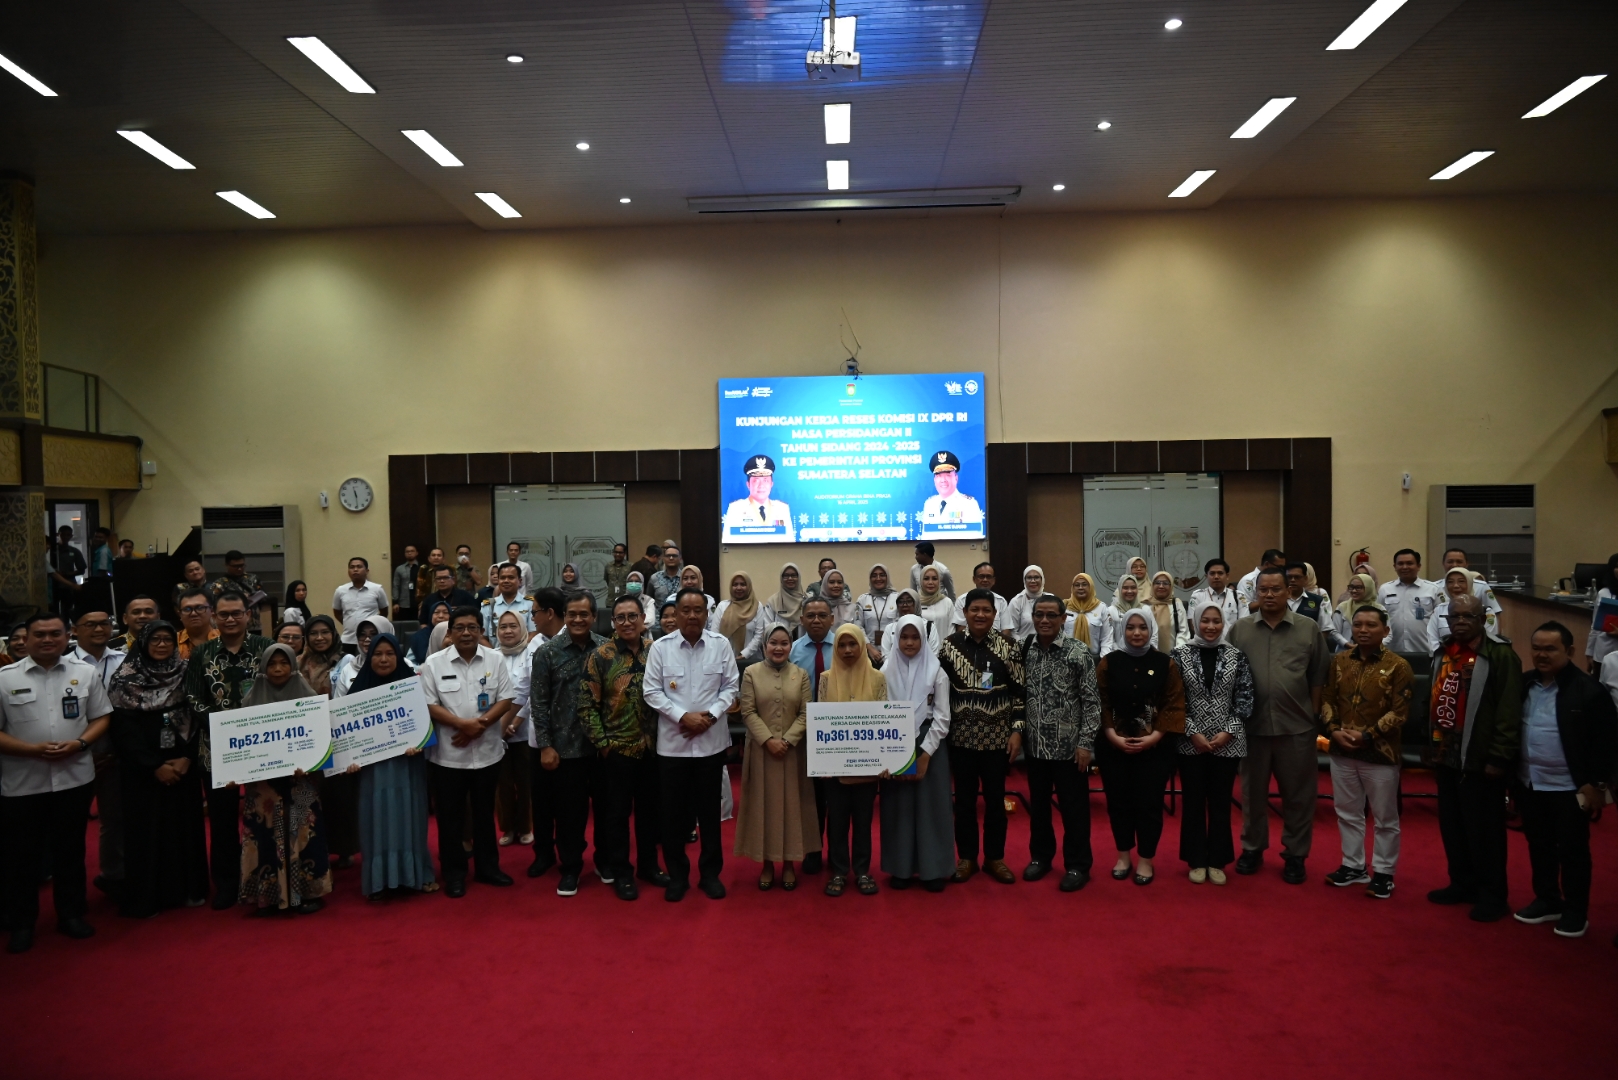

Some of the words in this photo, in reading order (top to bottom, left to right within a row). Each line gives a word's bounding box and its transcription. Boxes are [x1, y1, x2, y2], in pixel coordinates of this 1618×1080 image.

[736, 417, 802, 427] KUNJUNGAN
[805, 416, 839, 426] KERJA
[842, 415, 874, 425] RESES
[877, 414, 914, 424] KOMISI
[918, 413, 929, 423] IX
[931, 413, 954, 423] DPR
[956, 412, 967, 422] RI
[792, 429, 823, 439] MASA
[826, 428, 902, 438] PERSIDANGAN
[904, 428, 912, 437] II
[781, 443, 818, 453] TAHUN
[821, 442, 861, 452] SIDANG
[864, 442, 889, 451] 2024
[892, 441, 920, 451] -2025
[783, 457, 796, 466] KE
[800, 456, 868, 466] PEMERINTAH
[871, 454, 921, 465] PROVINSI
[798, 470, 856, 480] SUMATERA
[858, 469, 907, 479] SELATAN
[347, 701, 368, 709] JAMINAN
[360, 702, 380, 710] JAMINAN
[382, 696, 401, 704] PENSIUN
[220, 718, 247, 726] SANTUNAN
[229, 726, 312, 749] Rp52.211.410,-
[817, 729, 906, 744] Rp361.939.940,-
